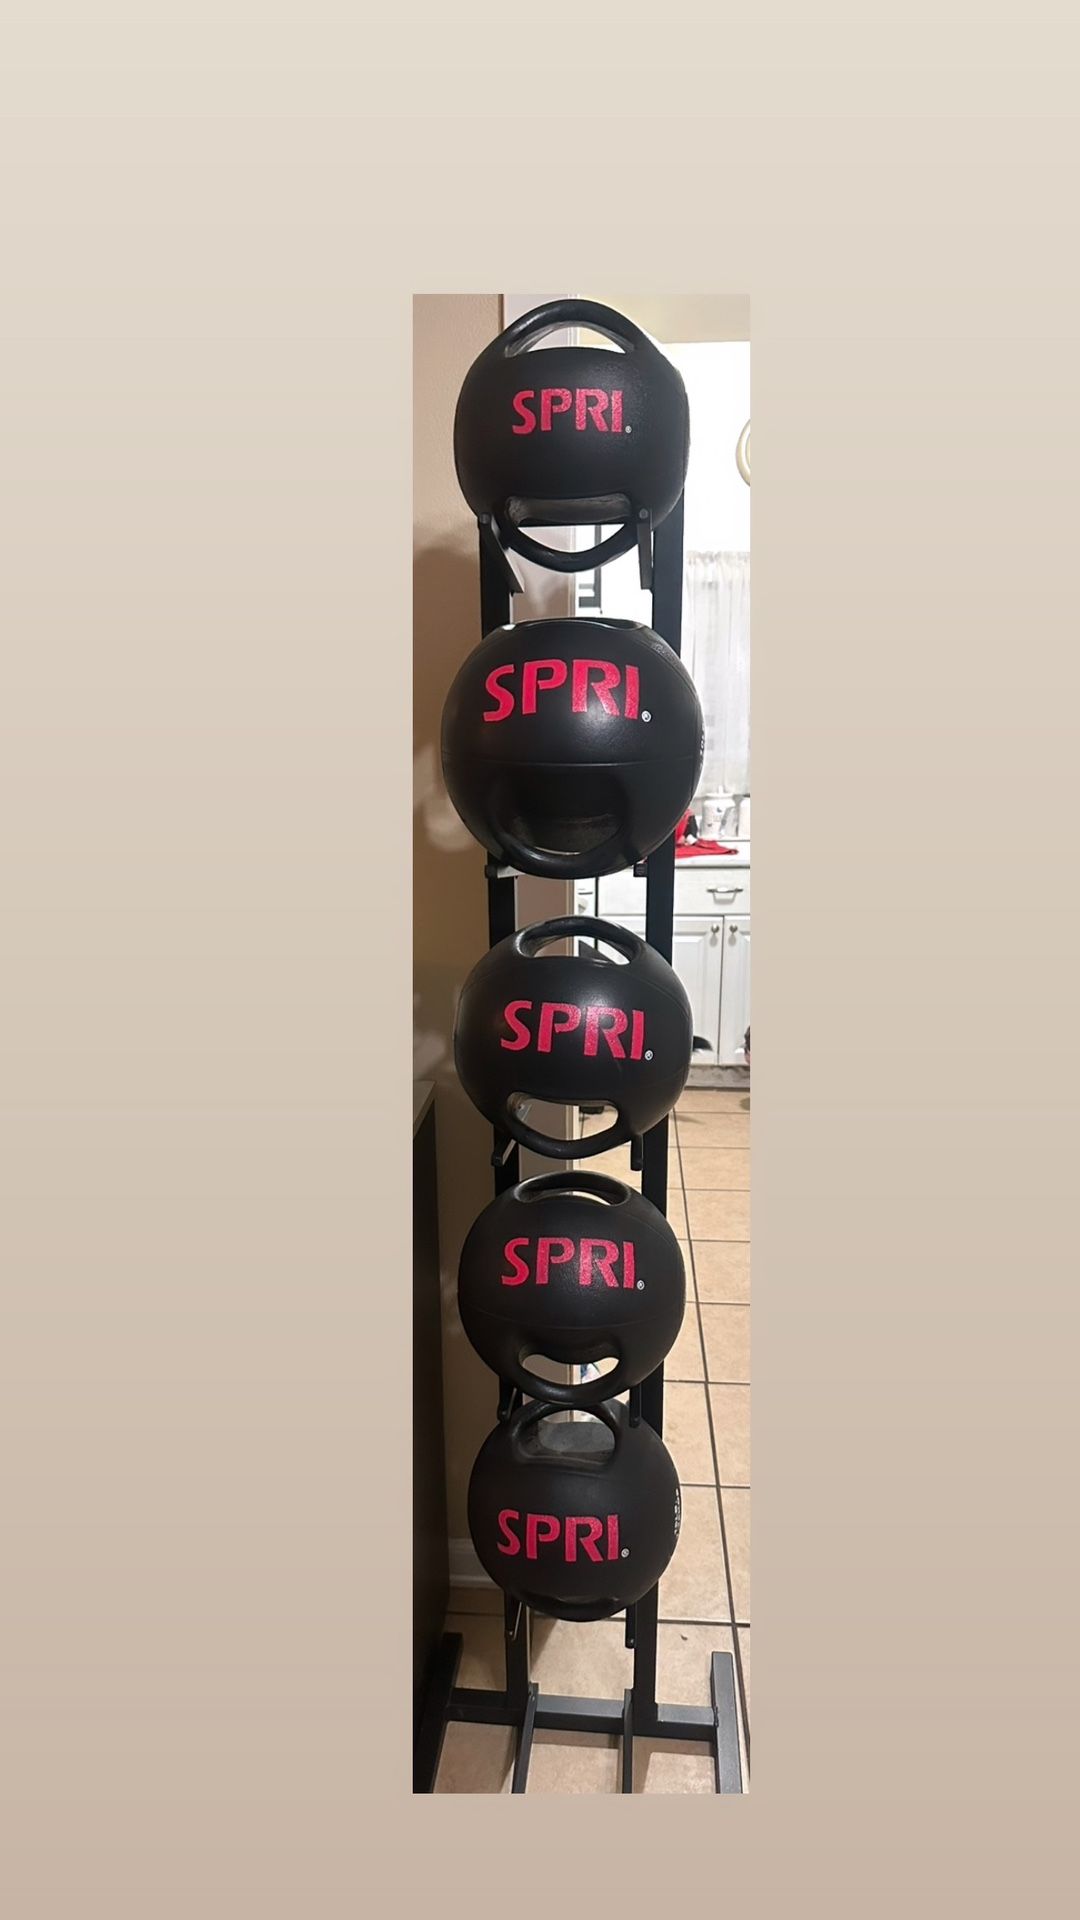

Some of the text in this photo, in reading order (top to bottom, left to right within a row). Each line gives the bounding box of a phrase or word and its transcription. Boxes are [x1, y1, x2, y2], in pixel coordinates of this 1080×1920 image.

[512, 388, 624, 435] SPRI
[483, 659, 640, 722] SPRI
[500, 1000, 646, 1060] SPRI
[501, 1237, 635, 1289] SPRI
[497, 1509, 620, 1562] SPRI
